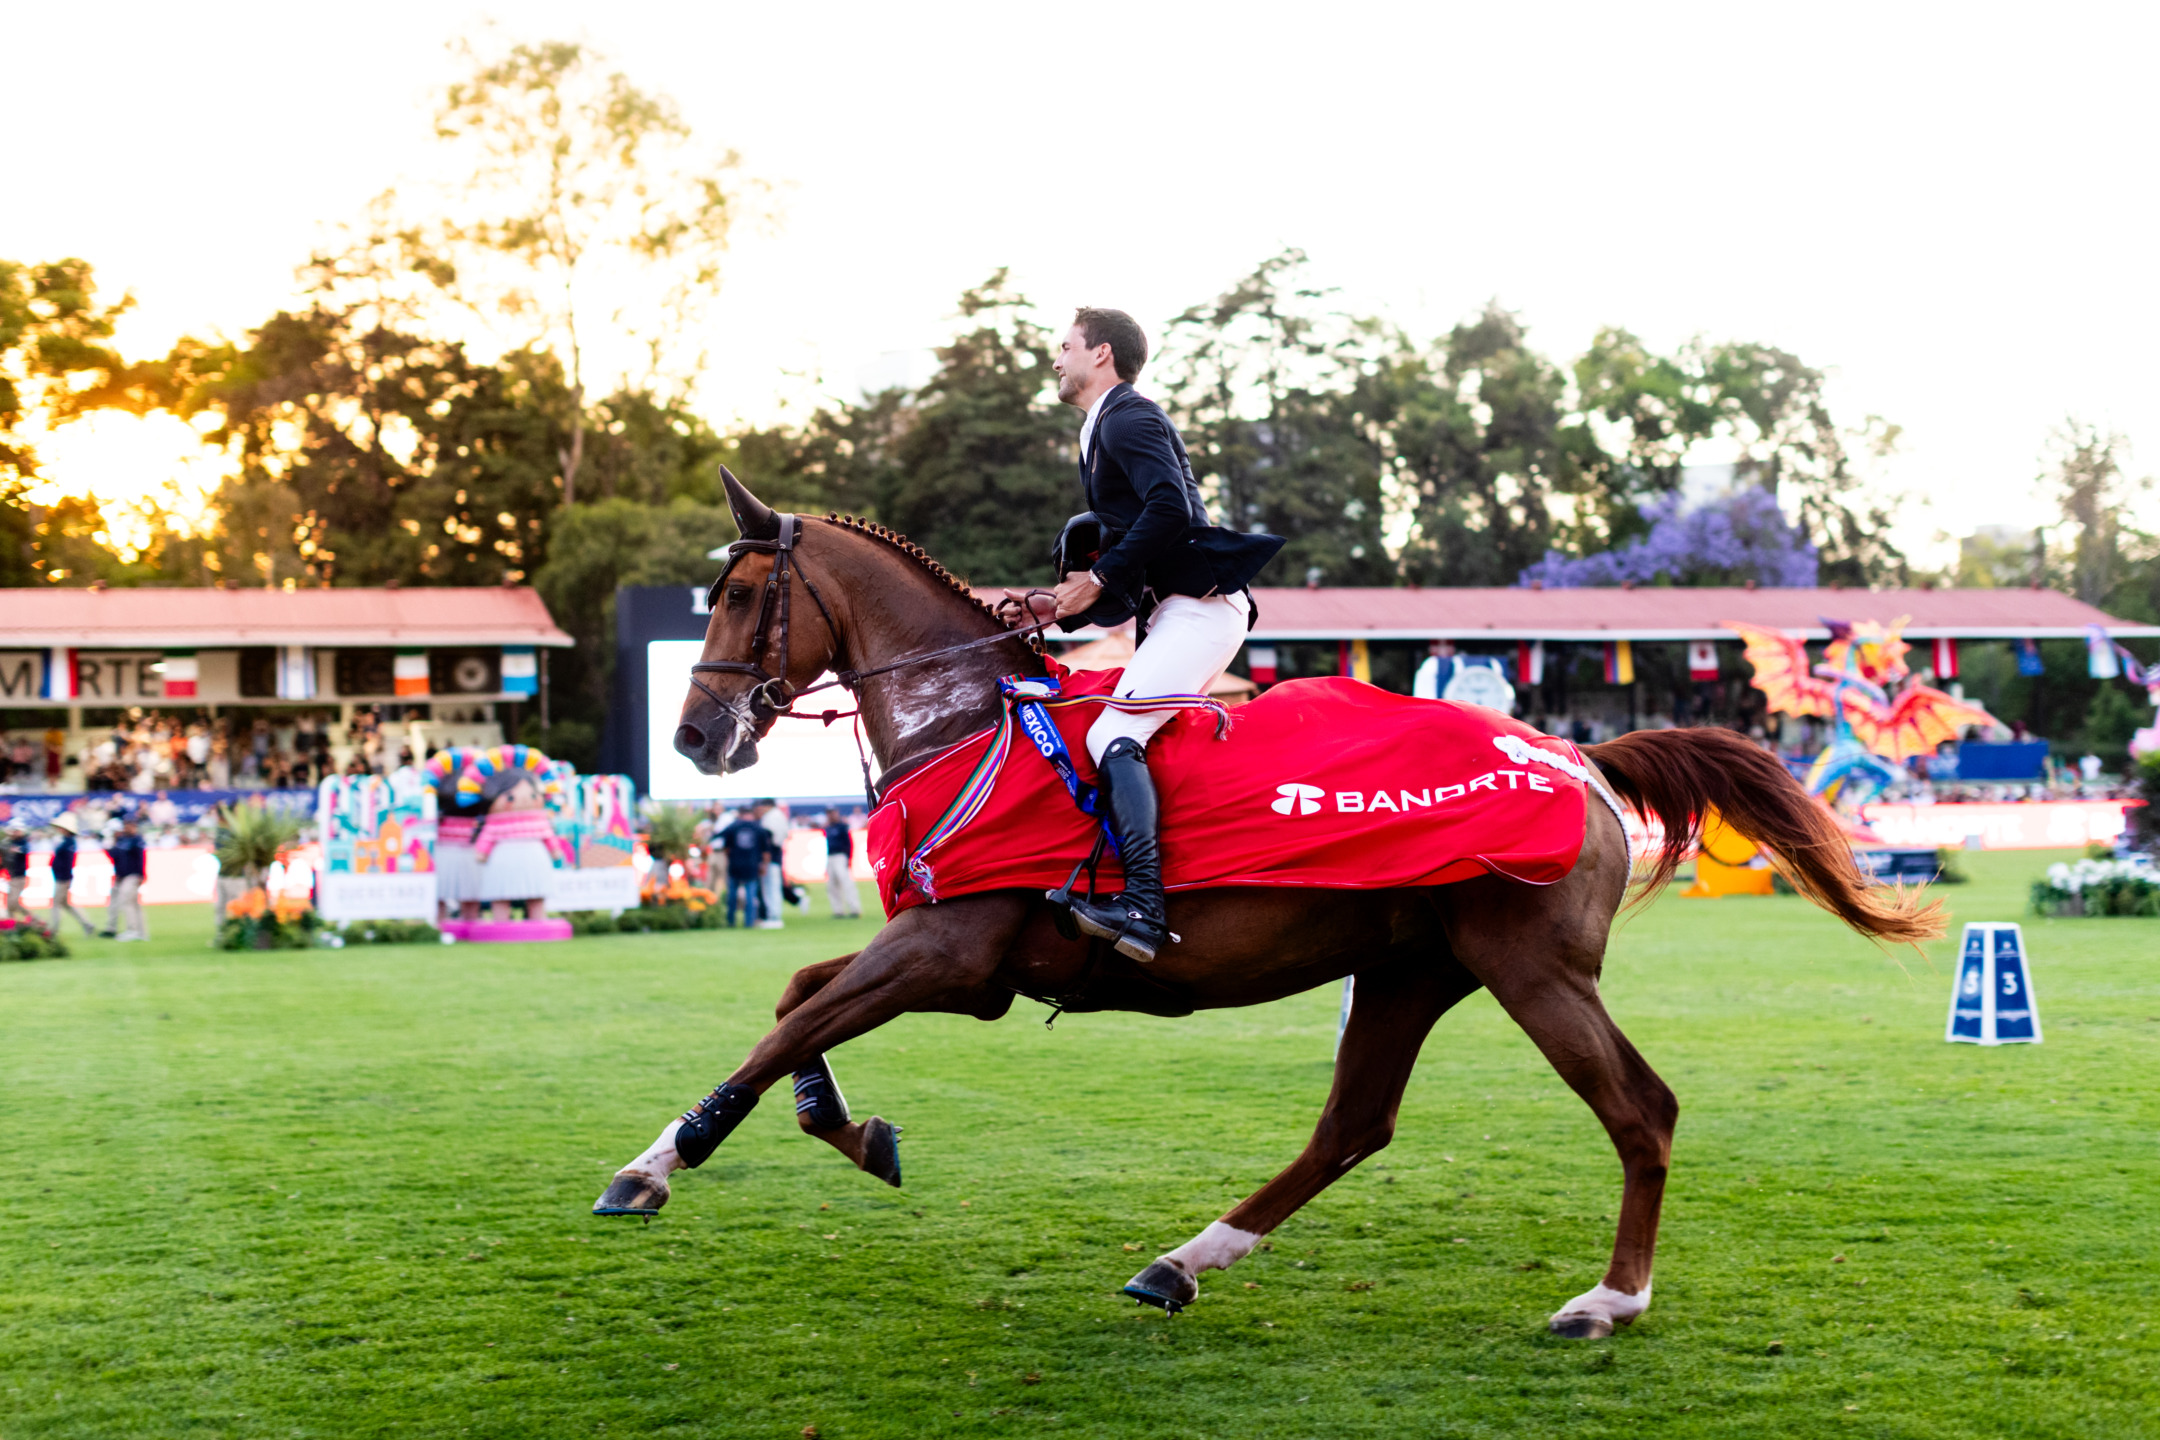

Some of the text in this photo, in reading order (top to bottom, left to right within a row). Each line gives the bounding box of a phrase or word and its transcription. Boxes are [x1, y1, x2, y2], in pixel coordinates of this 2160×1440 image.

[0, 658, 159, 697] MRTE
[1021, 704, 1055, 757] MEXICO
[1335, 770, 1554, 813] BANORTE
[2002, 971, 2019, 996] 3
